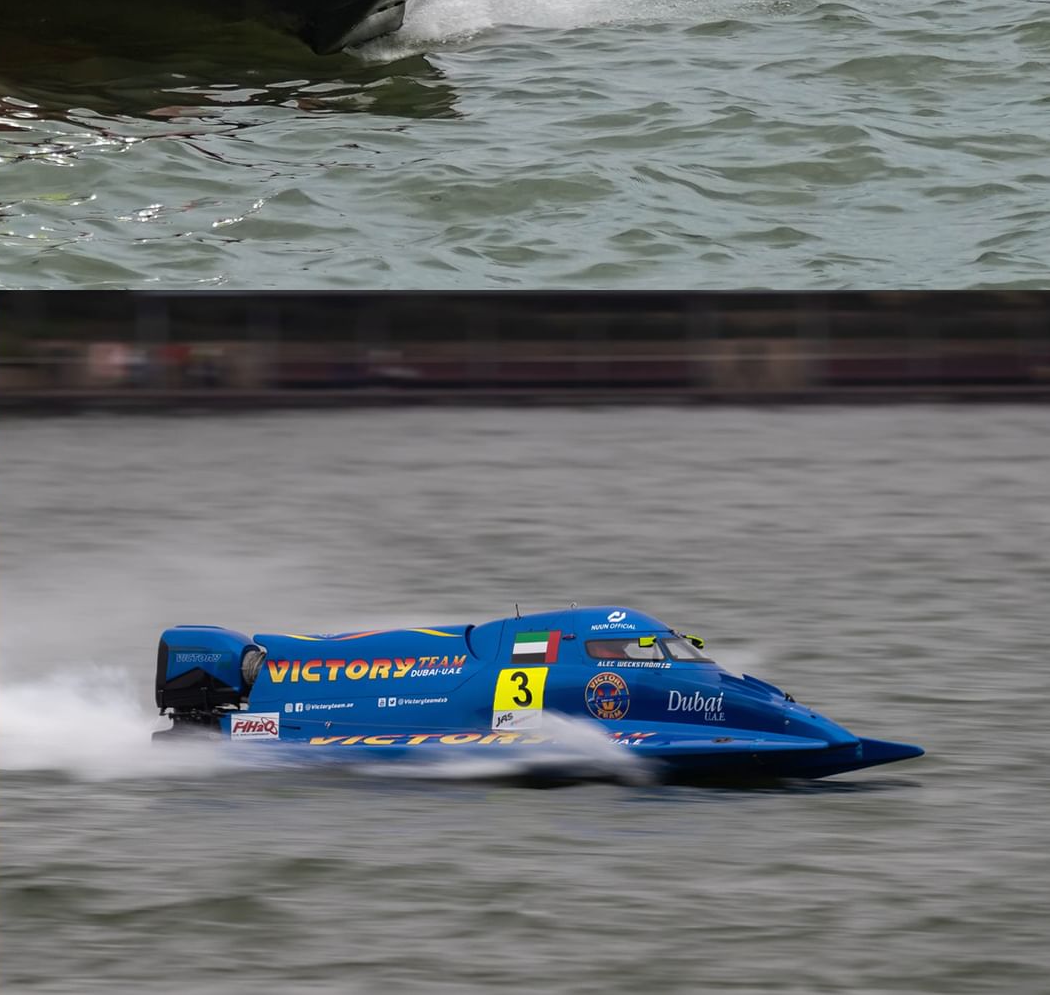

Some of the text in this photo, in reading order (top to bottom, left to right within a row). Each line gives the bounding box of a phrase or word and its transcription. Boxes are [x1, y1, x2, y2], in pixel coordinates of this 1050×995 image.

[266, 654, 467, 683] VICTORY TEAM
[510, 671, 533, 708] 3
[590, 675, 625, 689] VICTORY
[667, 690, 724, 712] Dubai
[496, 712, 514, 727] JAS
